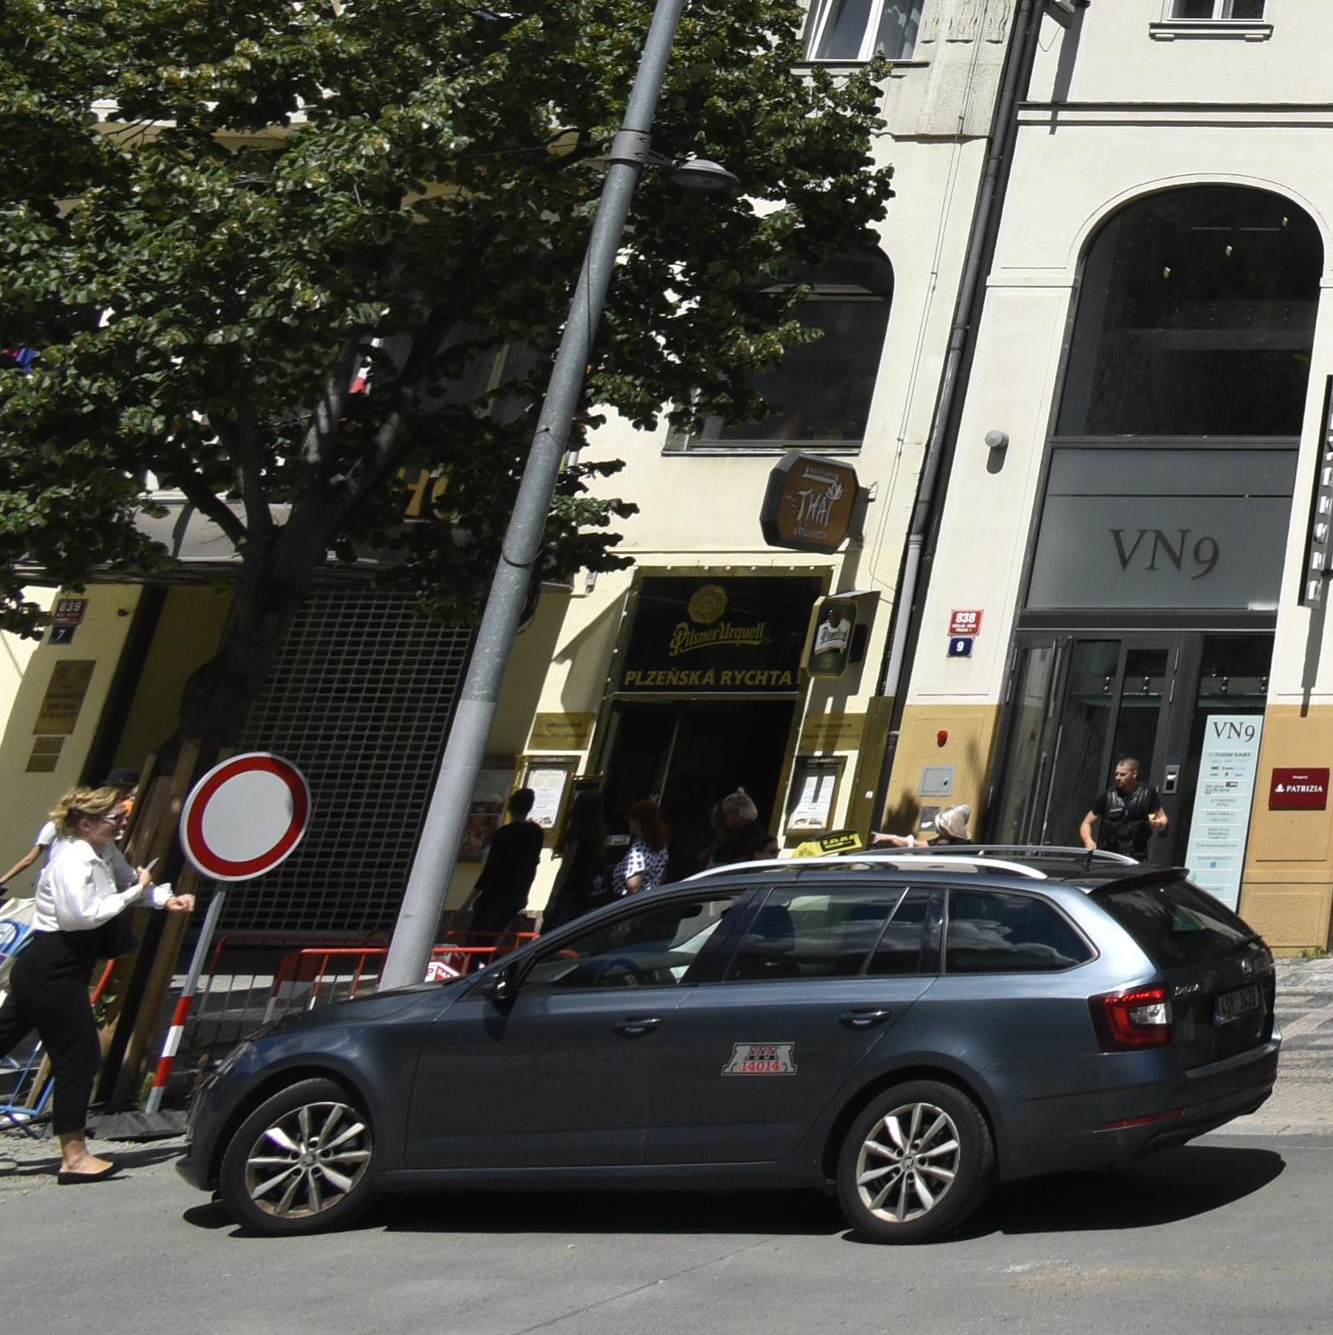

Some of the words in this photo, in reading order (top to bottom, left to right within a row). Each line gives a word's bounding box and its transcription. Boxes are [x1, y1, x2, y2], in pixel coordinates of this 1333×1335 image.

[1109, 528, 1221, 580] VN9
[956, 612, 977, 623] 838
[54, 629, 66, 640] 7
[669, 622, 719, 656] Pilsner
[719, 622, 767, 646] Urquell
[956, 641, 965, 652] 9
[624, 667, 716, 687] PLZEŇSKÁ
[720, 670, 793, 687] RYCHTA
[1213, 722, 1255, 742] VN9
[1286, 785, 1323, 793] PATRIZIA
[742, 1061, 782, 1072] 14014
